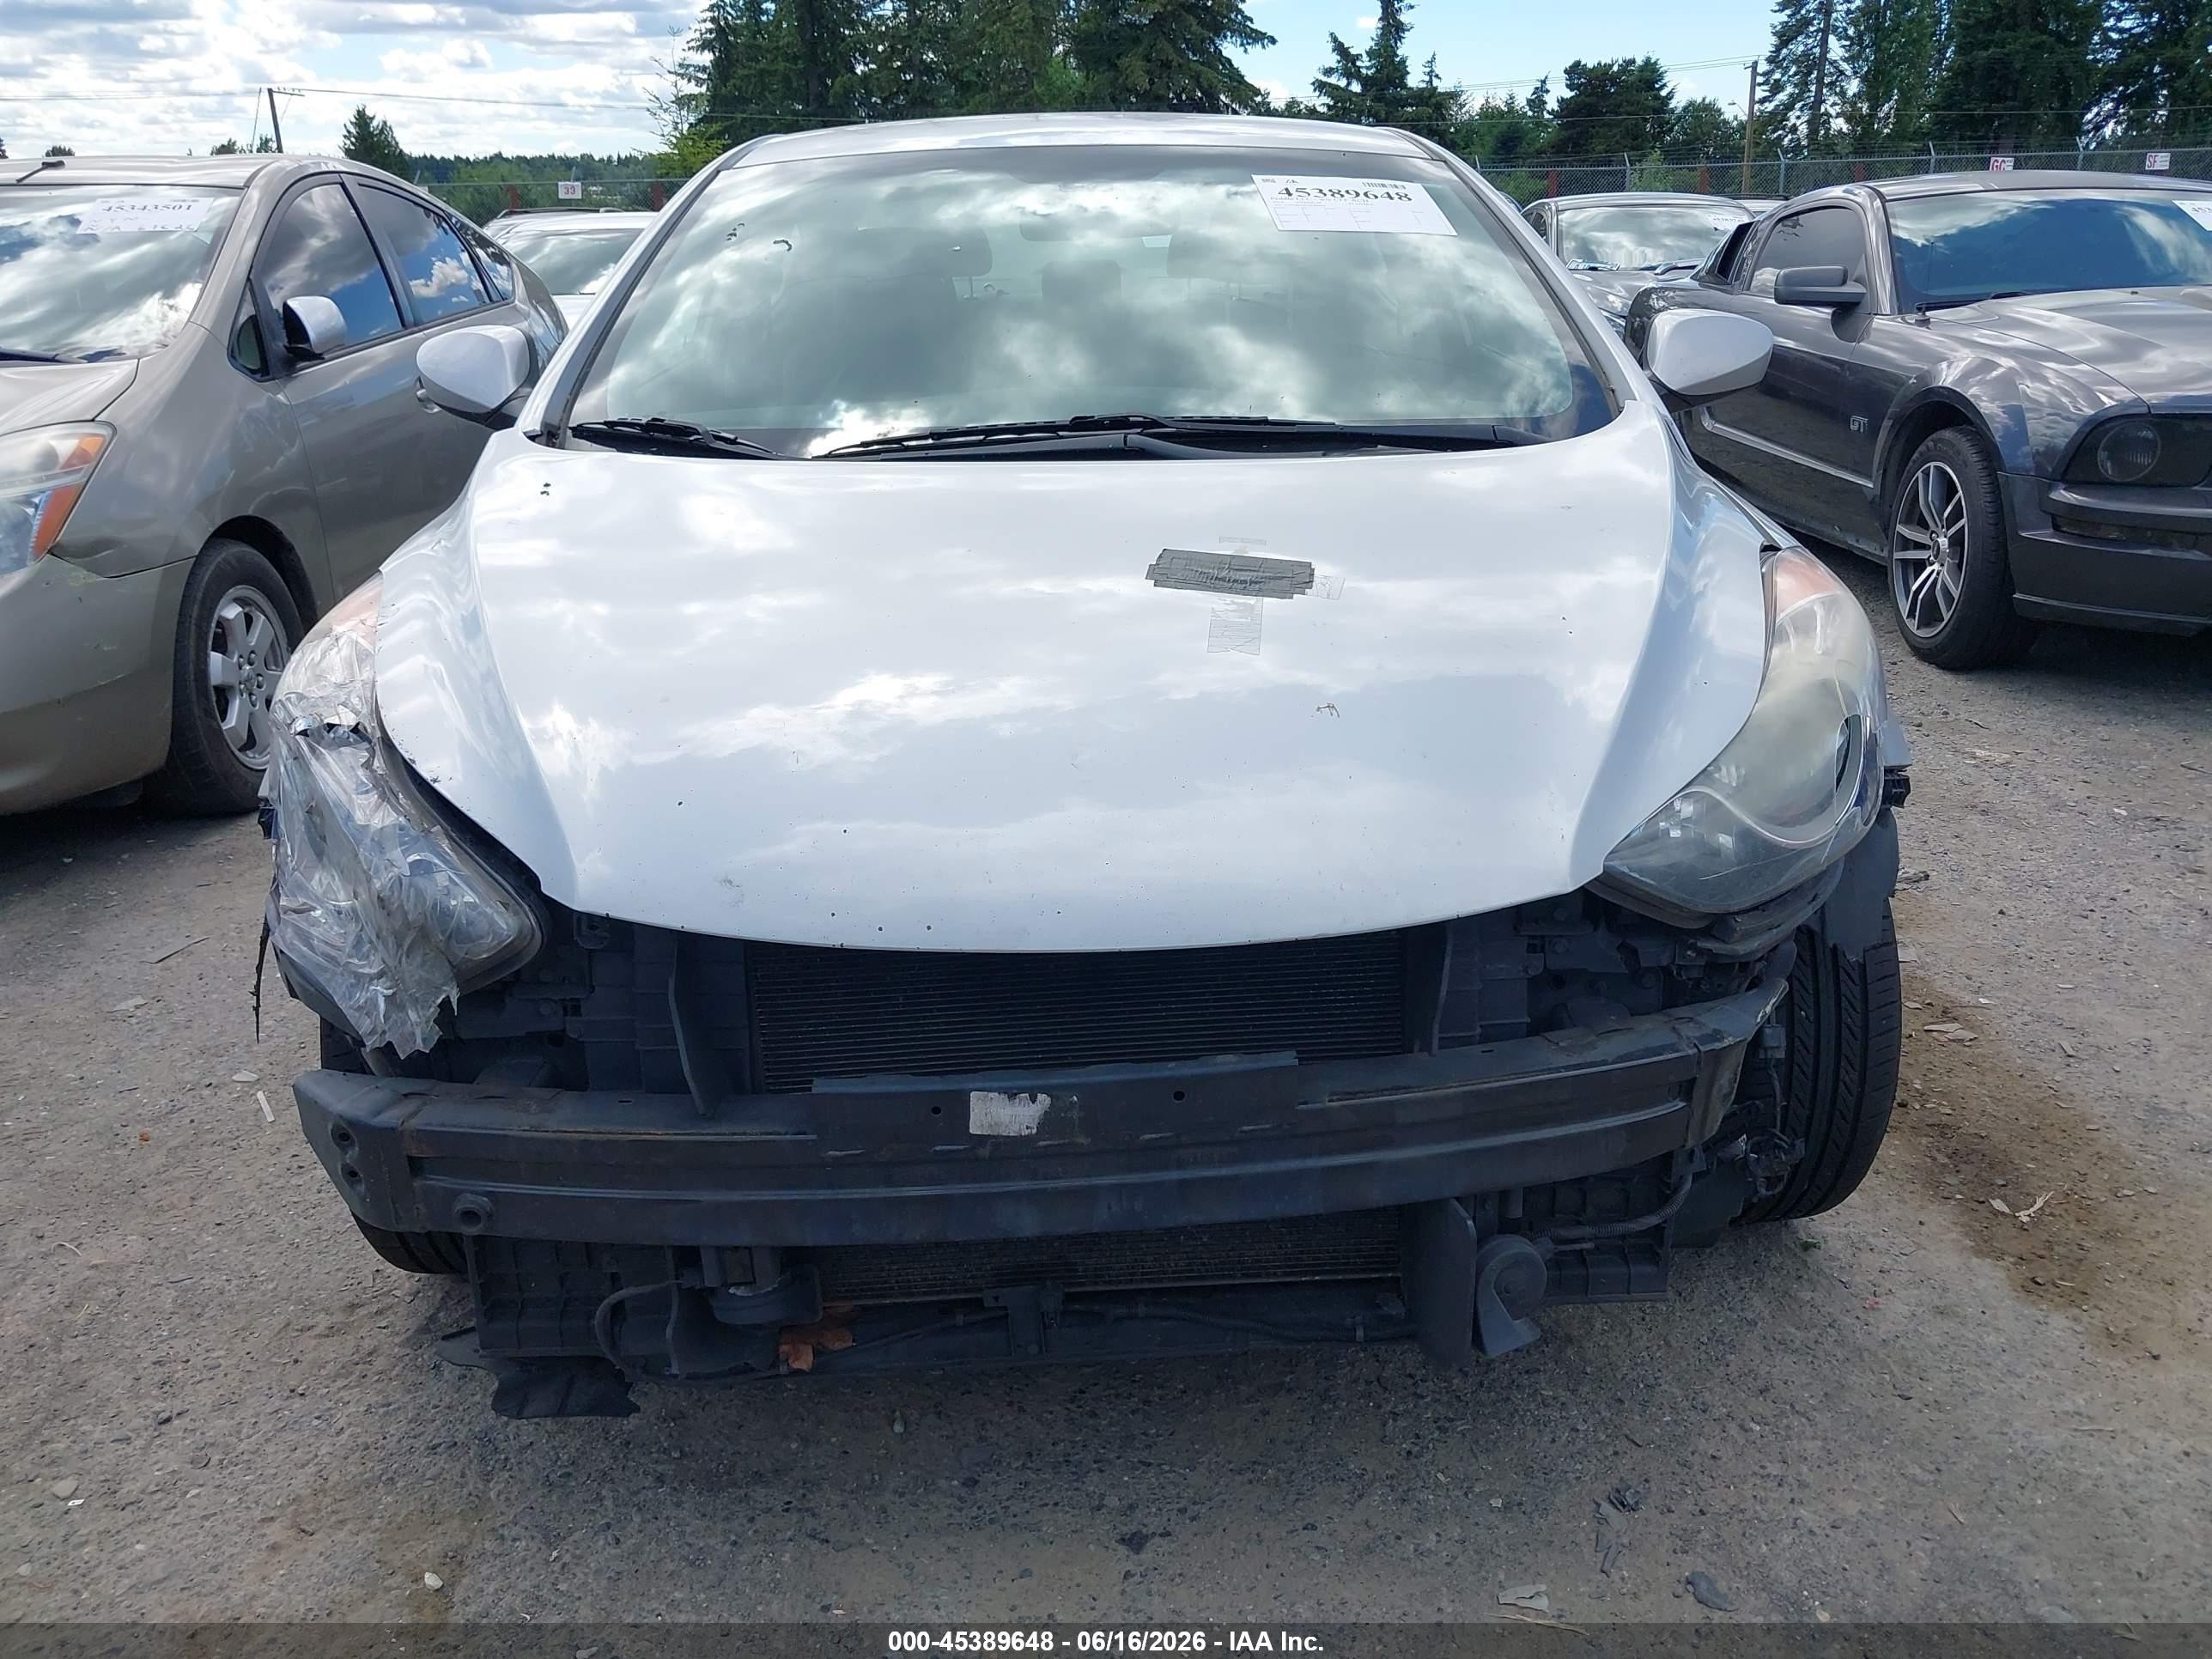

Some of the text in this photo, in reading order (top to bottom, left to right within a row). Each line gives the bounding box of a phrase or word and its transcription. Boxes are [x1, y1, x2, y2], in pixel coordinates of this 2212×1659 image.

[1991, 159, 2006, 171] GC
[2147, 155, 2159, 168] SF
[563, 185, 576, 195] 33
[1278, 186, 1413, 203] 45389648
[102, 204, 193, 213] 45343501
[1849, 415, 1869, 433] GT
